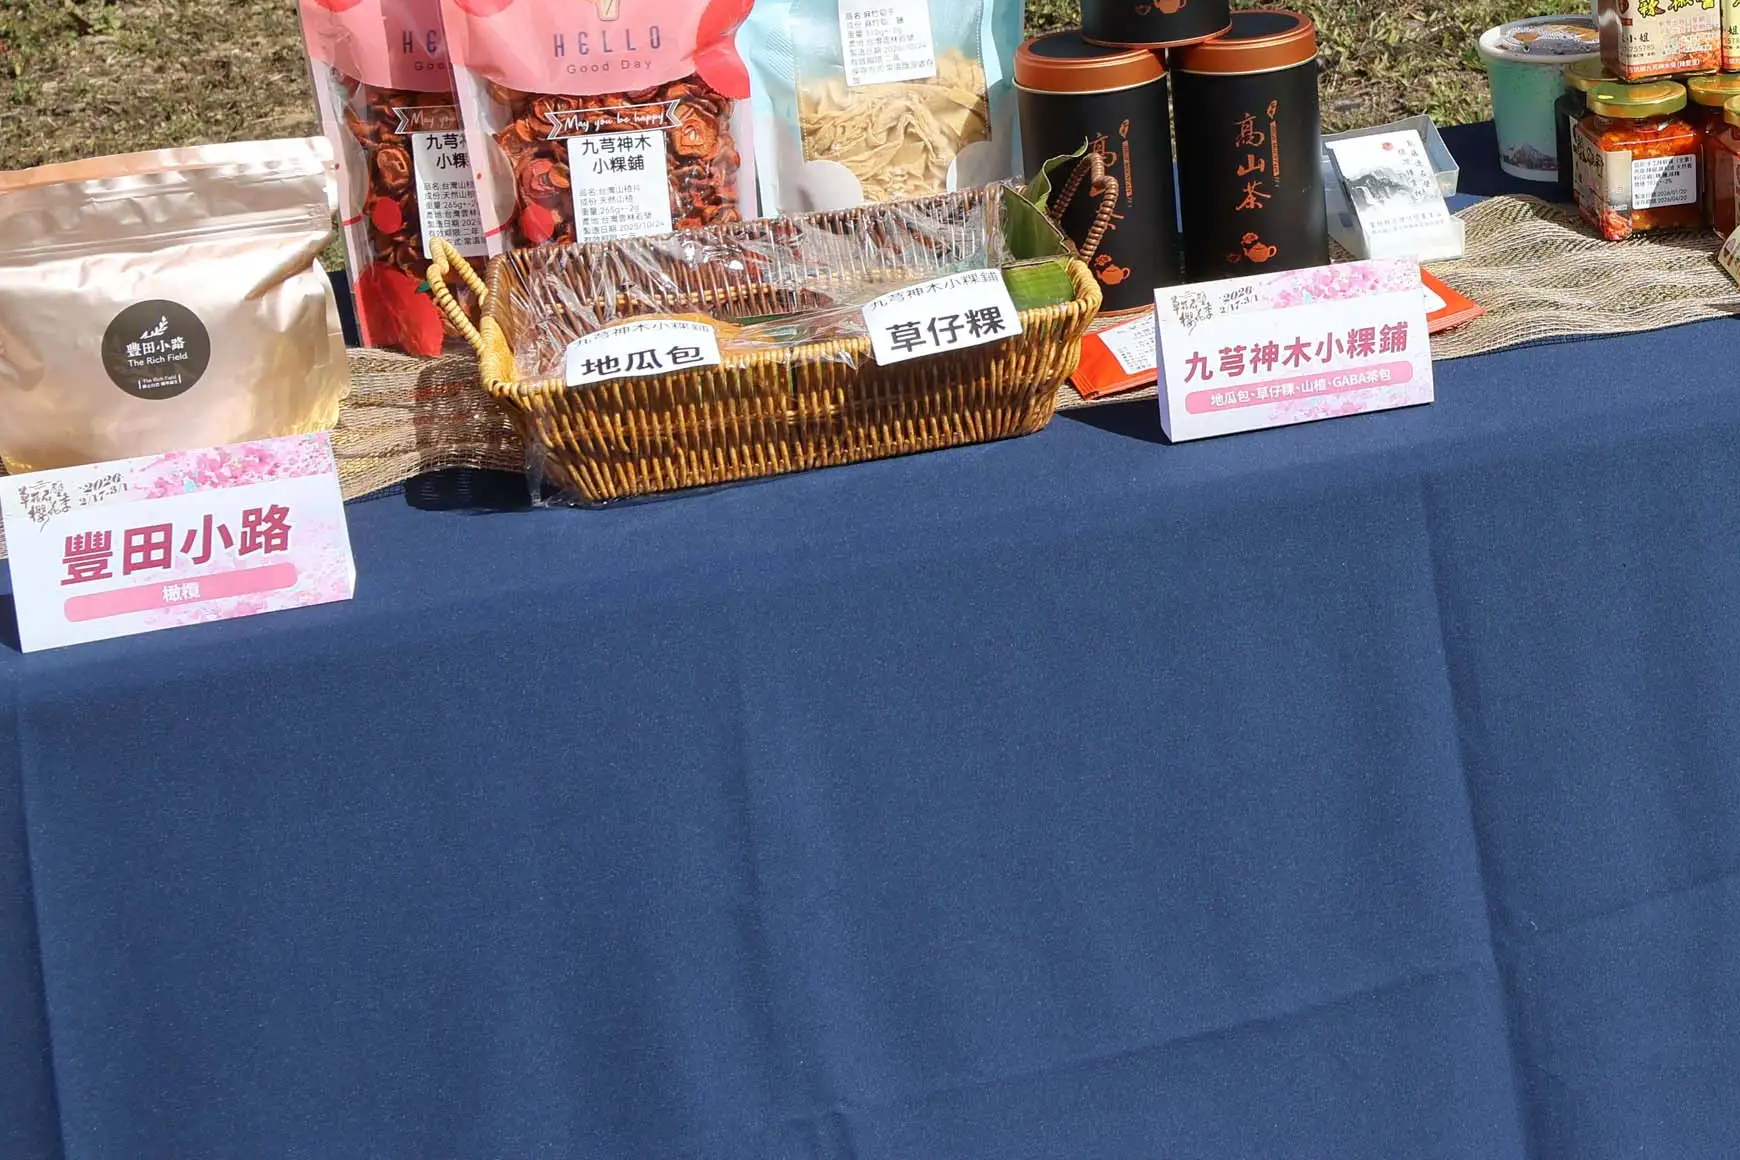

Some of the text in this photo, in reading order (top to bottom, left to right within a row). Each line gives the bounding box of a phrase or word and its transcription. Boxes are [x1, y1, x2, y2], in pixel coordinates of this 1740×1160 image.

[553, 26, 662, 57] HELLO
[566, 59, 653, 74] Good Day
[563, 110, 666, 133] May you be happy
[582, 134, 652, 155] 九芎神木
[592, 154, 645, 174] 小粿鋪
[1231, 112, 1272, 212] 高山茶
[885, 305, 1006, 352] 草仔粿
[126, 336, 187, 358] 豐田小路
[1184, 320, 1410, 384] 九芎神木小粿鋪
[128, 351, 189, 368] The Rich Field
[580, 345, 705, 376] 地瓜包
[83, 472, 122, 494] 2026
[60, 503, 293, 587] 豐田小路
